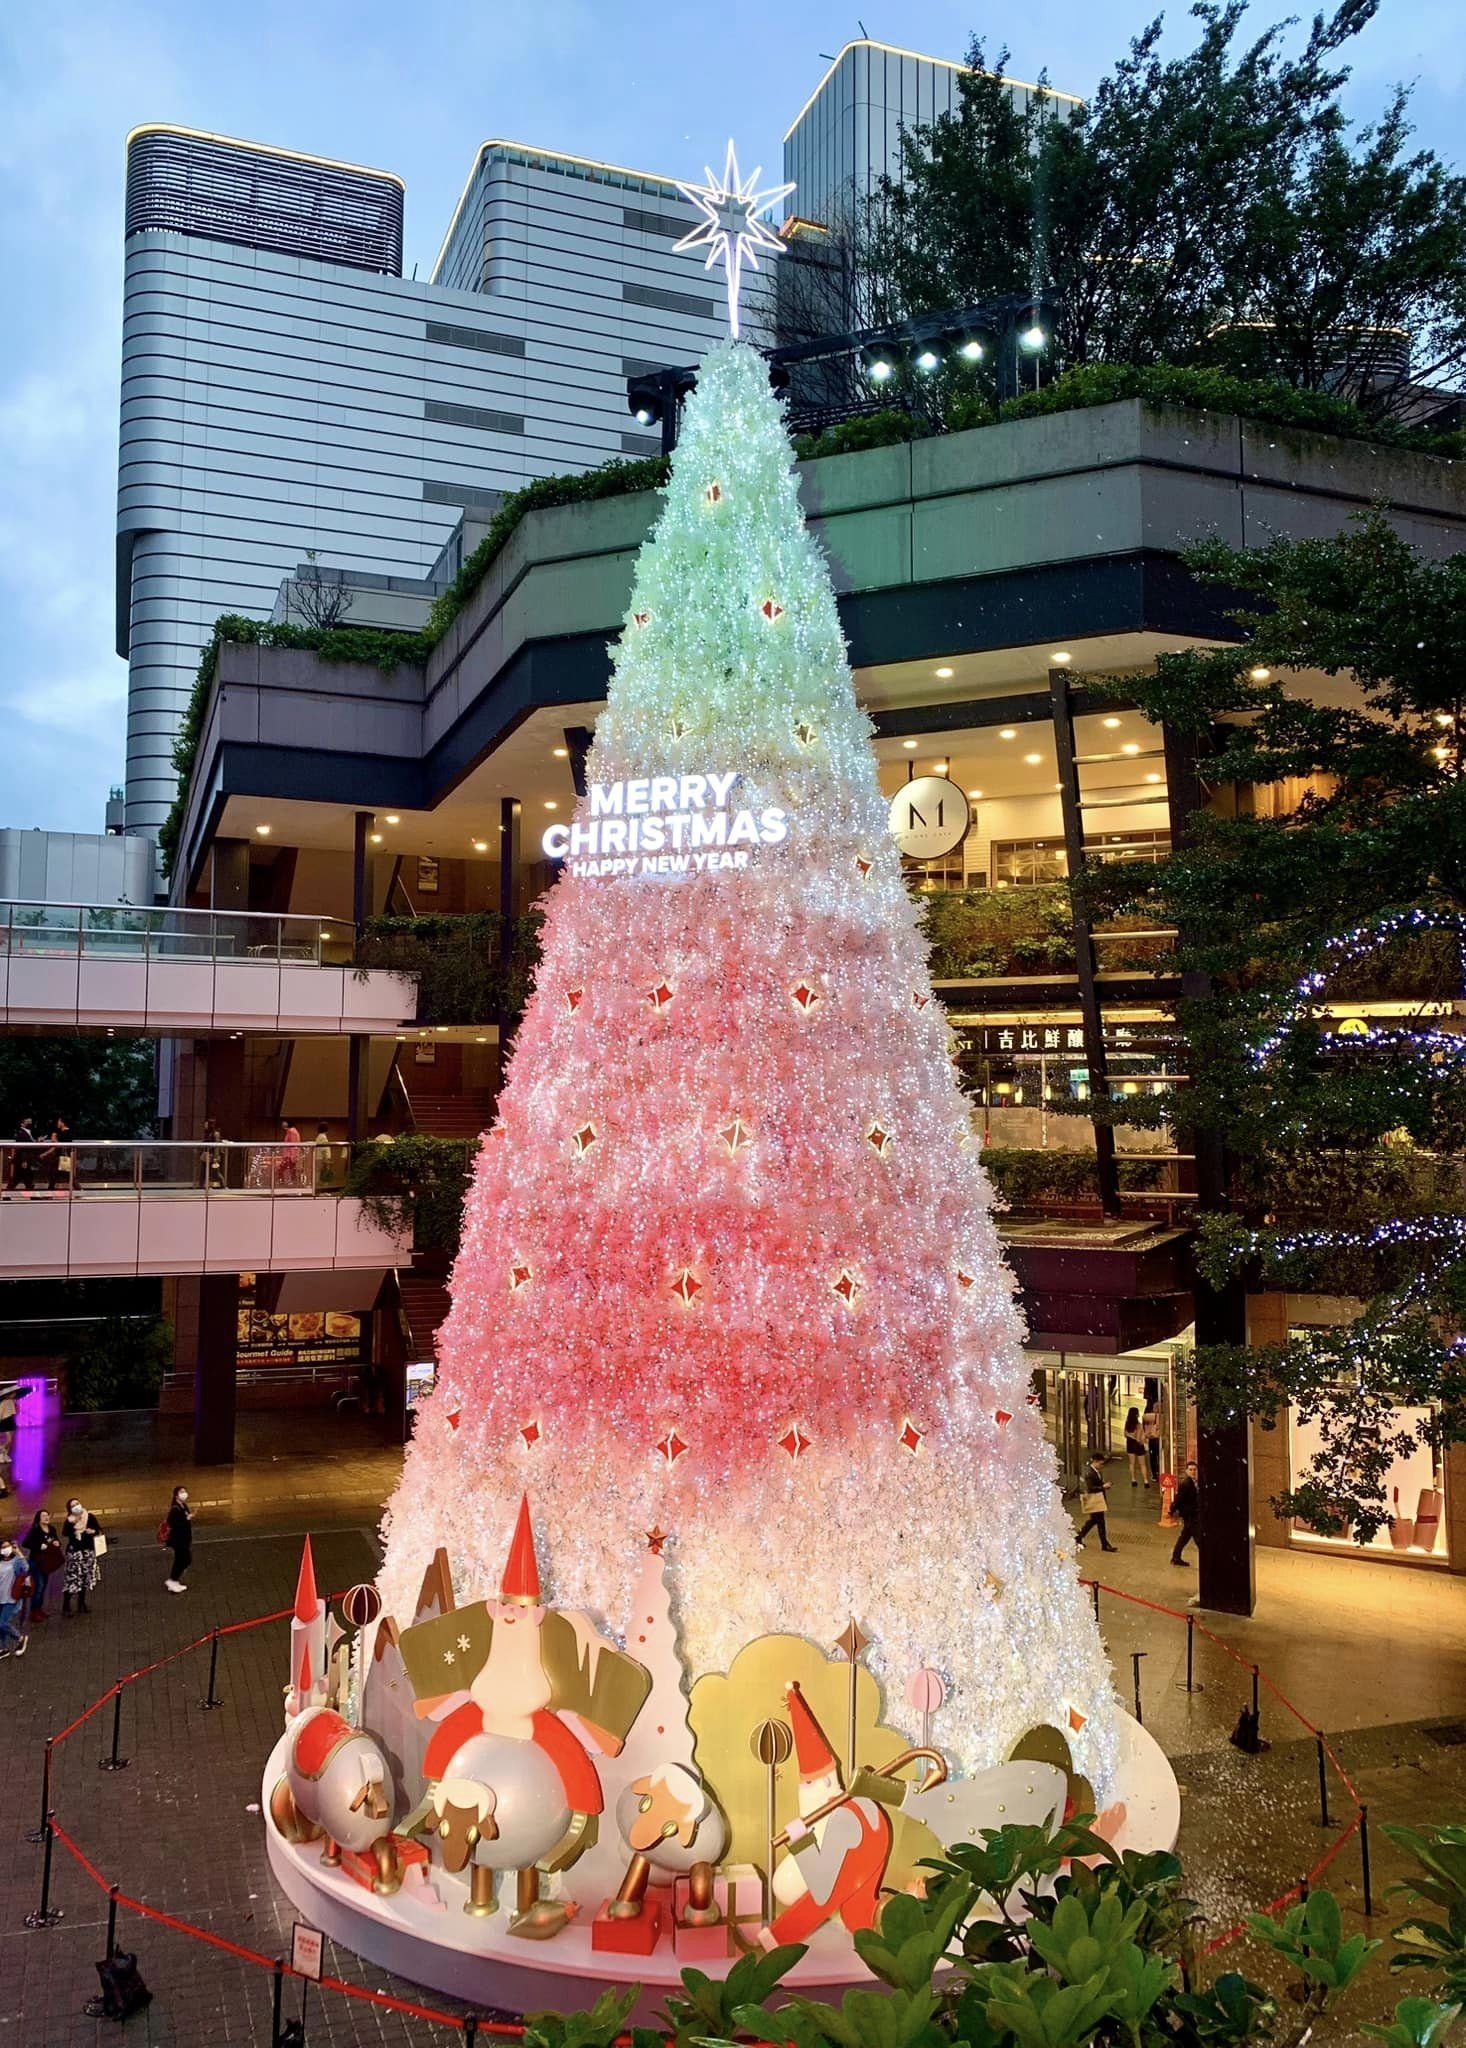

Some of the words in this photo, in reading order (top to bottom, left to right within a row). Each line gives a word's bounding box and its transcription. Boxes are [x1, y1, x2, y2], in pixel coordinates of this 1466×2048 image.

[590, 772, 738, 817] MERRY
[542, 806, 788, 858] CHRISTMAS
[572, 857, 639, 878] HAPPY
[641, 856, 690, 874] NEW
[689, 851, 749, 870] YEAR
